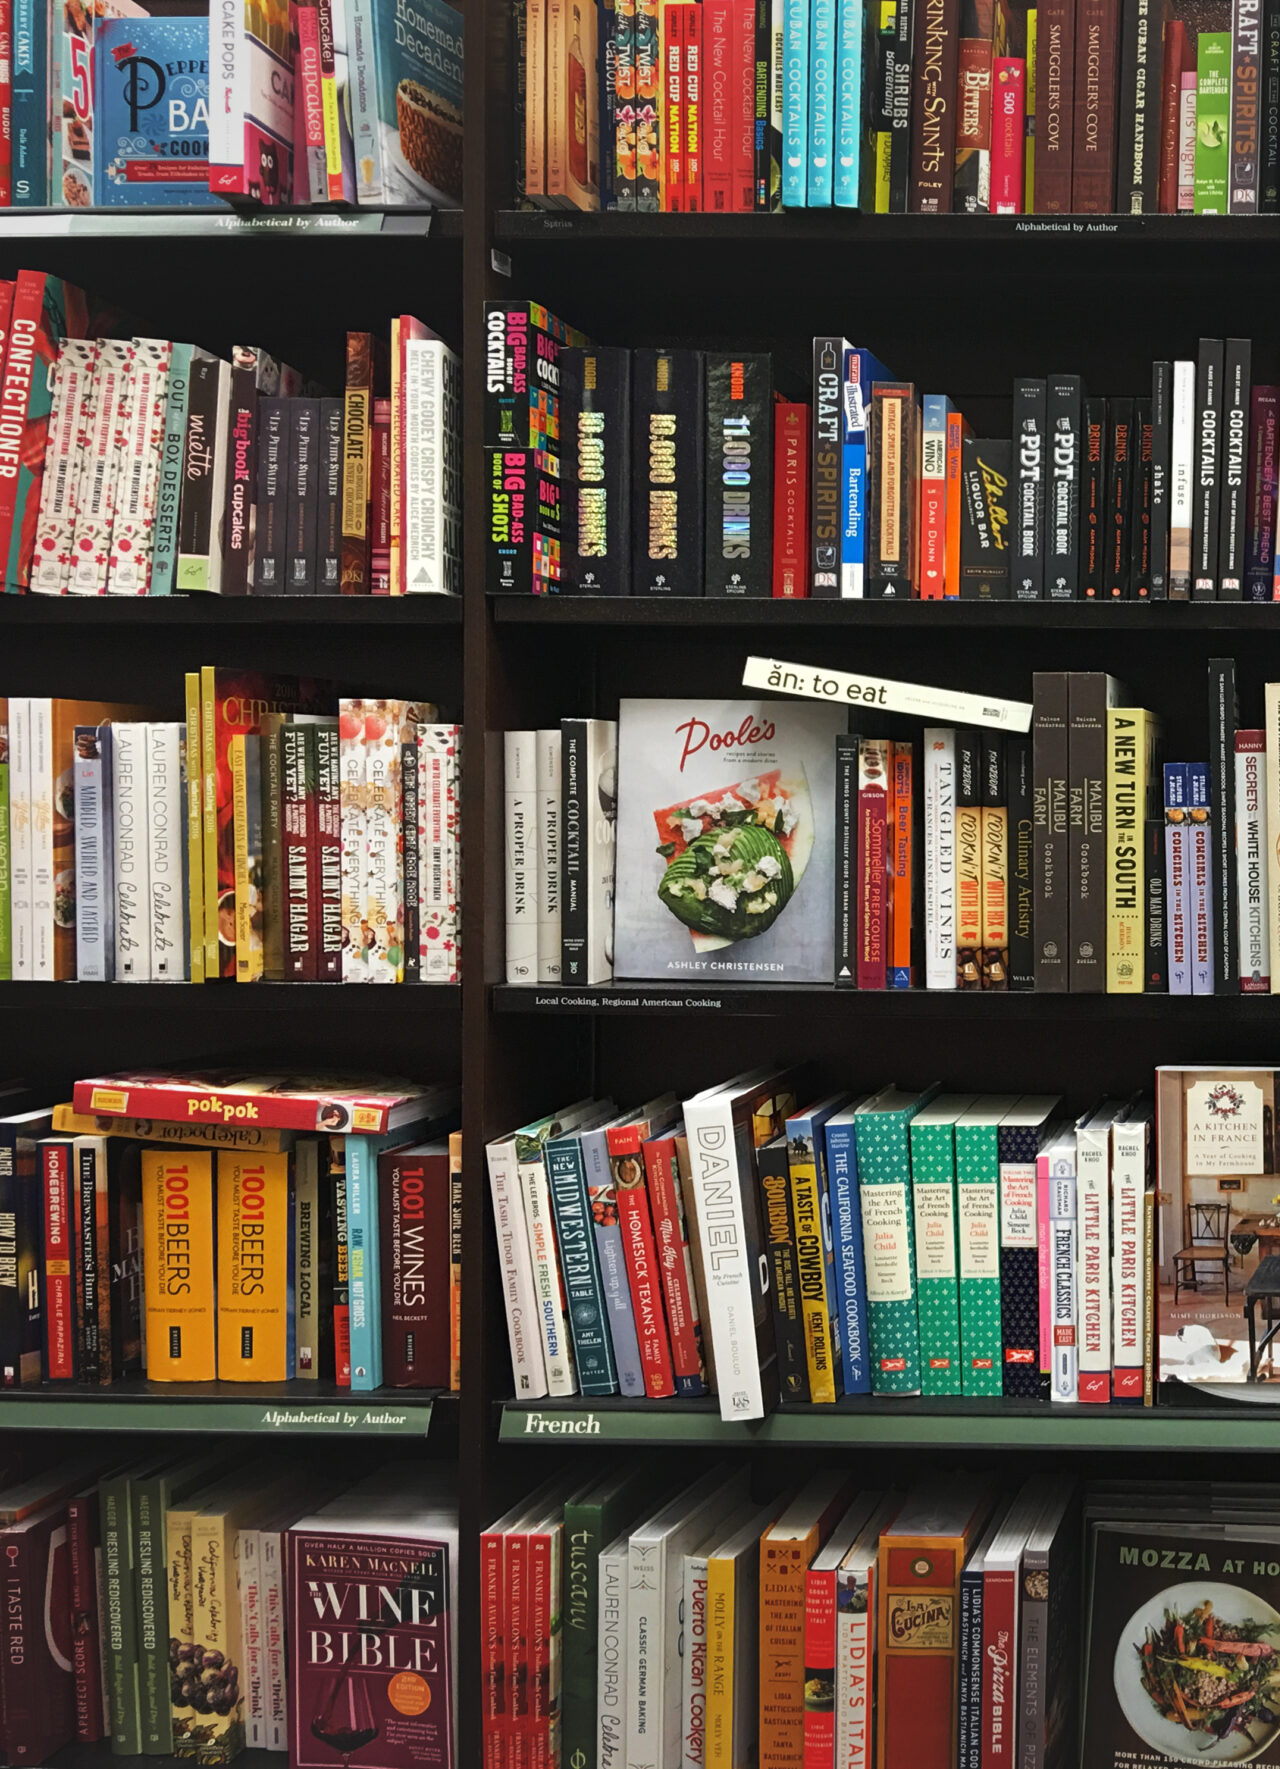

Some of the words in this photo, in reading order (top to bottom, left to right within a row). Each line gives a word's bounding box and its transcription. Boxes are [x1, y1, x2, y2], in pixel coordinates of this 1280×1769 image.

[669, 45, 680, 71] RED
[1048, 25, 1061, 110] SMUGGLER'S
[303, 47, 324, 141] cupcakes
[669, 74, 680, 102] CUP
[893, 64, 909, 128] SHRUBS
[669, 106, 680, 153] NATION
[1048, 113, 1059, 151] COVE
[215, 216, 292, 230] Alphabetical
[296, 217, 311, 230] by
[314, 216, 359, 228] Author
[1016, 222, 1071, 232] Alphabetical
[1074, 222, 1083, 233] by
[1086, 222, 1117, 231] Author
[0, 319, 37, 479] CONFECTIONER
[818, 374, 838, 442] CRAFT
[188, 412, 213, 480] miette
[346, 393, 364, 460] CHOCOLATE
[577, 412, 605, 482] 10,000
[816, 452, 837, 539] SPIRITS
[577, 488, 607, 557] DRINKS
[813, 673, 838, 696] to
[847, 683, 887, 705] eat
[675, 715, 776, 772] Poole's
[1114, 718, 1130, 730] A
[117, 729, 132, 796] LAUREN
[1114, 736, 1135, 776] NEW
[940, 763, 952, 874] TANGLED
[1035, 788, 1046, 825] FARM
[1054, 780, 1066, 833] MALIBU
[1114, 781, 1135, 829] TURN
[118, 799, 134, 874] CONRAD
[288, 845, 306, 897] SAMMY
[1115, 846, 1136, 909] SOUTH
[118, 882, 138, 953] Celebrate
[289, 899, 308, 953] HAGAR
[940, 885, 952, 960] VINES
[667, 961, 707, 970] ASHLEY
[711, 962, 784, 971] CHRISTENSEN
[535, 997, 558, 1005] Local
[561, 997, 598, 1007] Cooking,
[602, 998, 639, 1008] Regional
[642, 998, 683, 1007] American
[686, 999, 721, 1008] Cooking
[187, 1096, 222, 1115] pok
[224, 1102, 258, 1120] pok
[1211, 1135, 1257, 1143] FRANCE
[165, 1165, 188, 1220] 1001
[401, 1168, 424, 1219] 1001
[697, 1126, 739, 1270] DANIEL
[1084, 1193, 1099, 1240] LITTLE
[554, 1173, 590, 1287] MIDWESTERN
[166, 1223, 190, 1296] BEERS
[402, 1225, 425, 1306] WINES
[1085, 1242, 1099, 1283] PARIS
[1085, 1289, 1100, 1352] KITCHEN
[261, 1411, 340, 1426] Alphabetical
[344, 1412, 358, 1427] by
[362, 1412, 406, 1424] Author
[525, 1414, 600, 1434] French
[306, 1554, 360, 1569] KAREN
[570, 1529, 594, 1629] tuscany
[1119, 1547, 1210, 1572] MOZZA
[1222, 1560, 1245, 1572] AT
[306, 1581, 438, 1627] WINE
[891, 1606, 953, 1637] CUCINA
[307, 1631, 438, 1672] BIBLE
